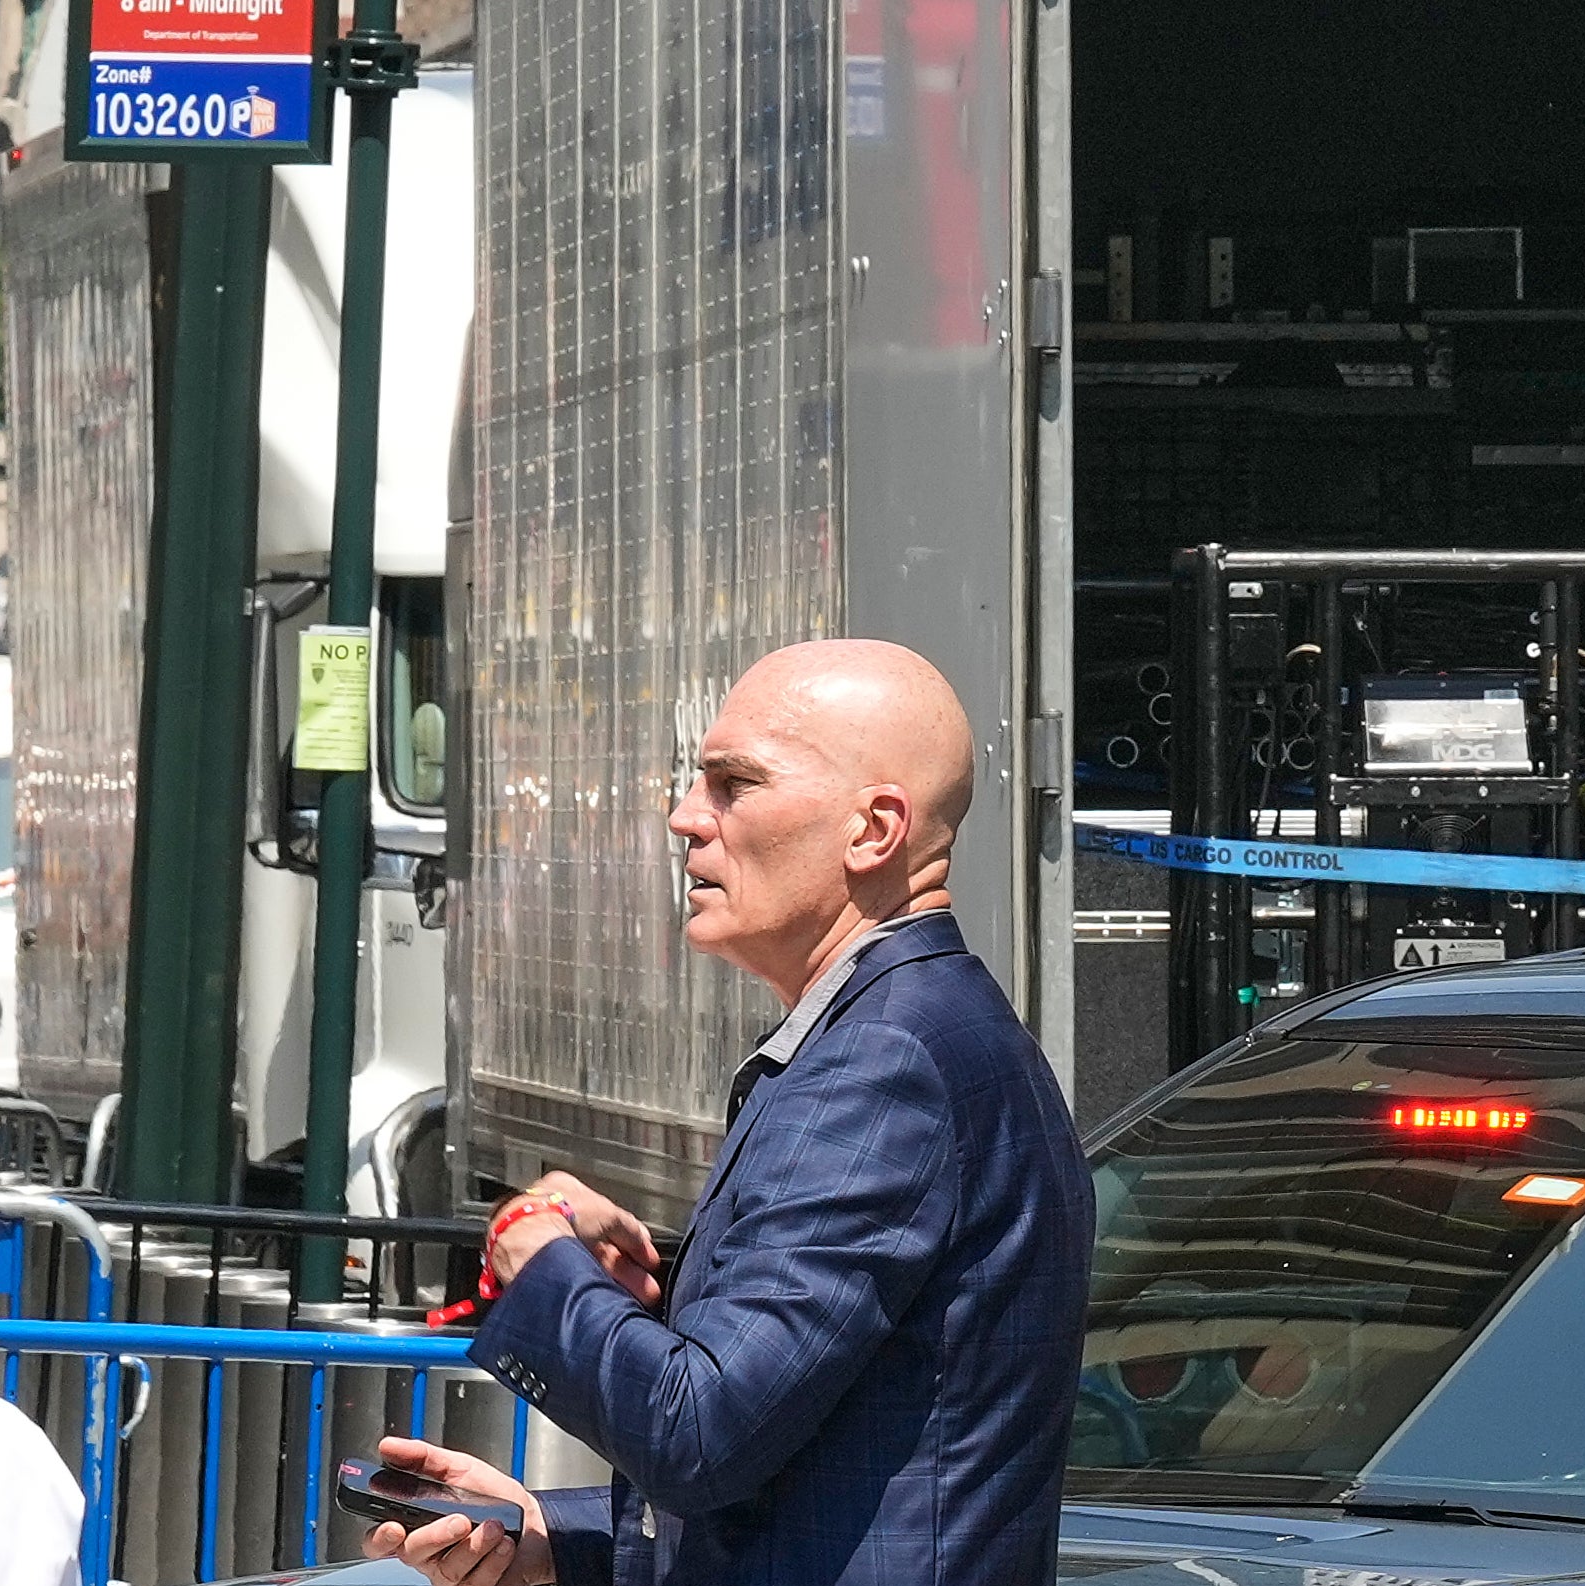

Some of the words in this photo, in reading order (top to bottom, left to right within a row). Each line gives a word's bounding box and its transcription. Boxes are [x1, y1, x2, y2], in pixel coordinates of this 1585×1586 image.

[143, 29, 191, 41] Department
[192, 30, 201, 40] of
[202, 30, 259, 42] Transportation
[95, 65, 152, 84] Zone#
[95, 92, 227, 137] 103260
[320, 643, 350, 660] NO
[1431, 741, 1496, 761] MDG
[1149, 841, 1169, 860] US
[1174, 842, 1232, 865] CARGO
[1243, 848, 1345, 871] CONTROL
